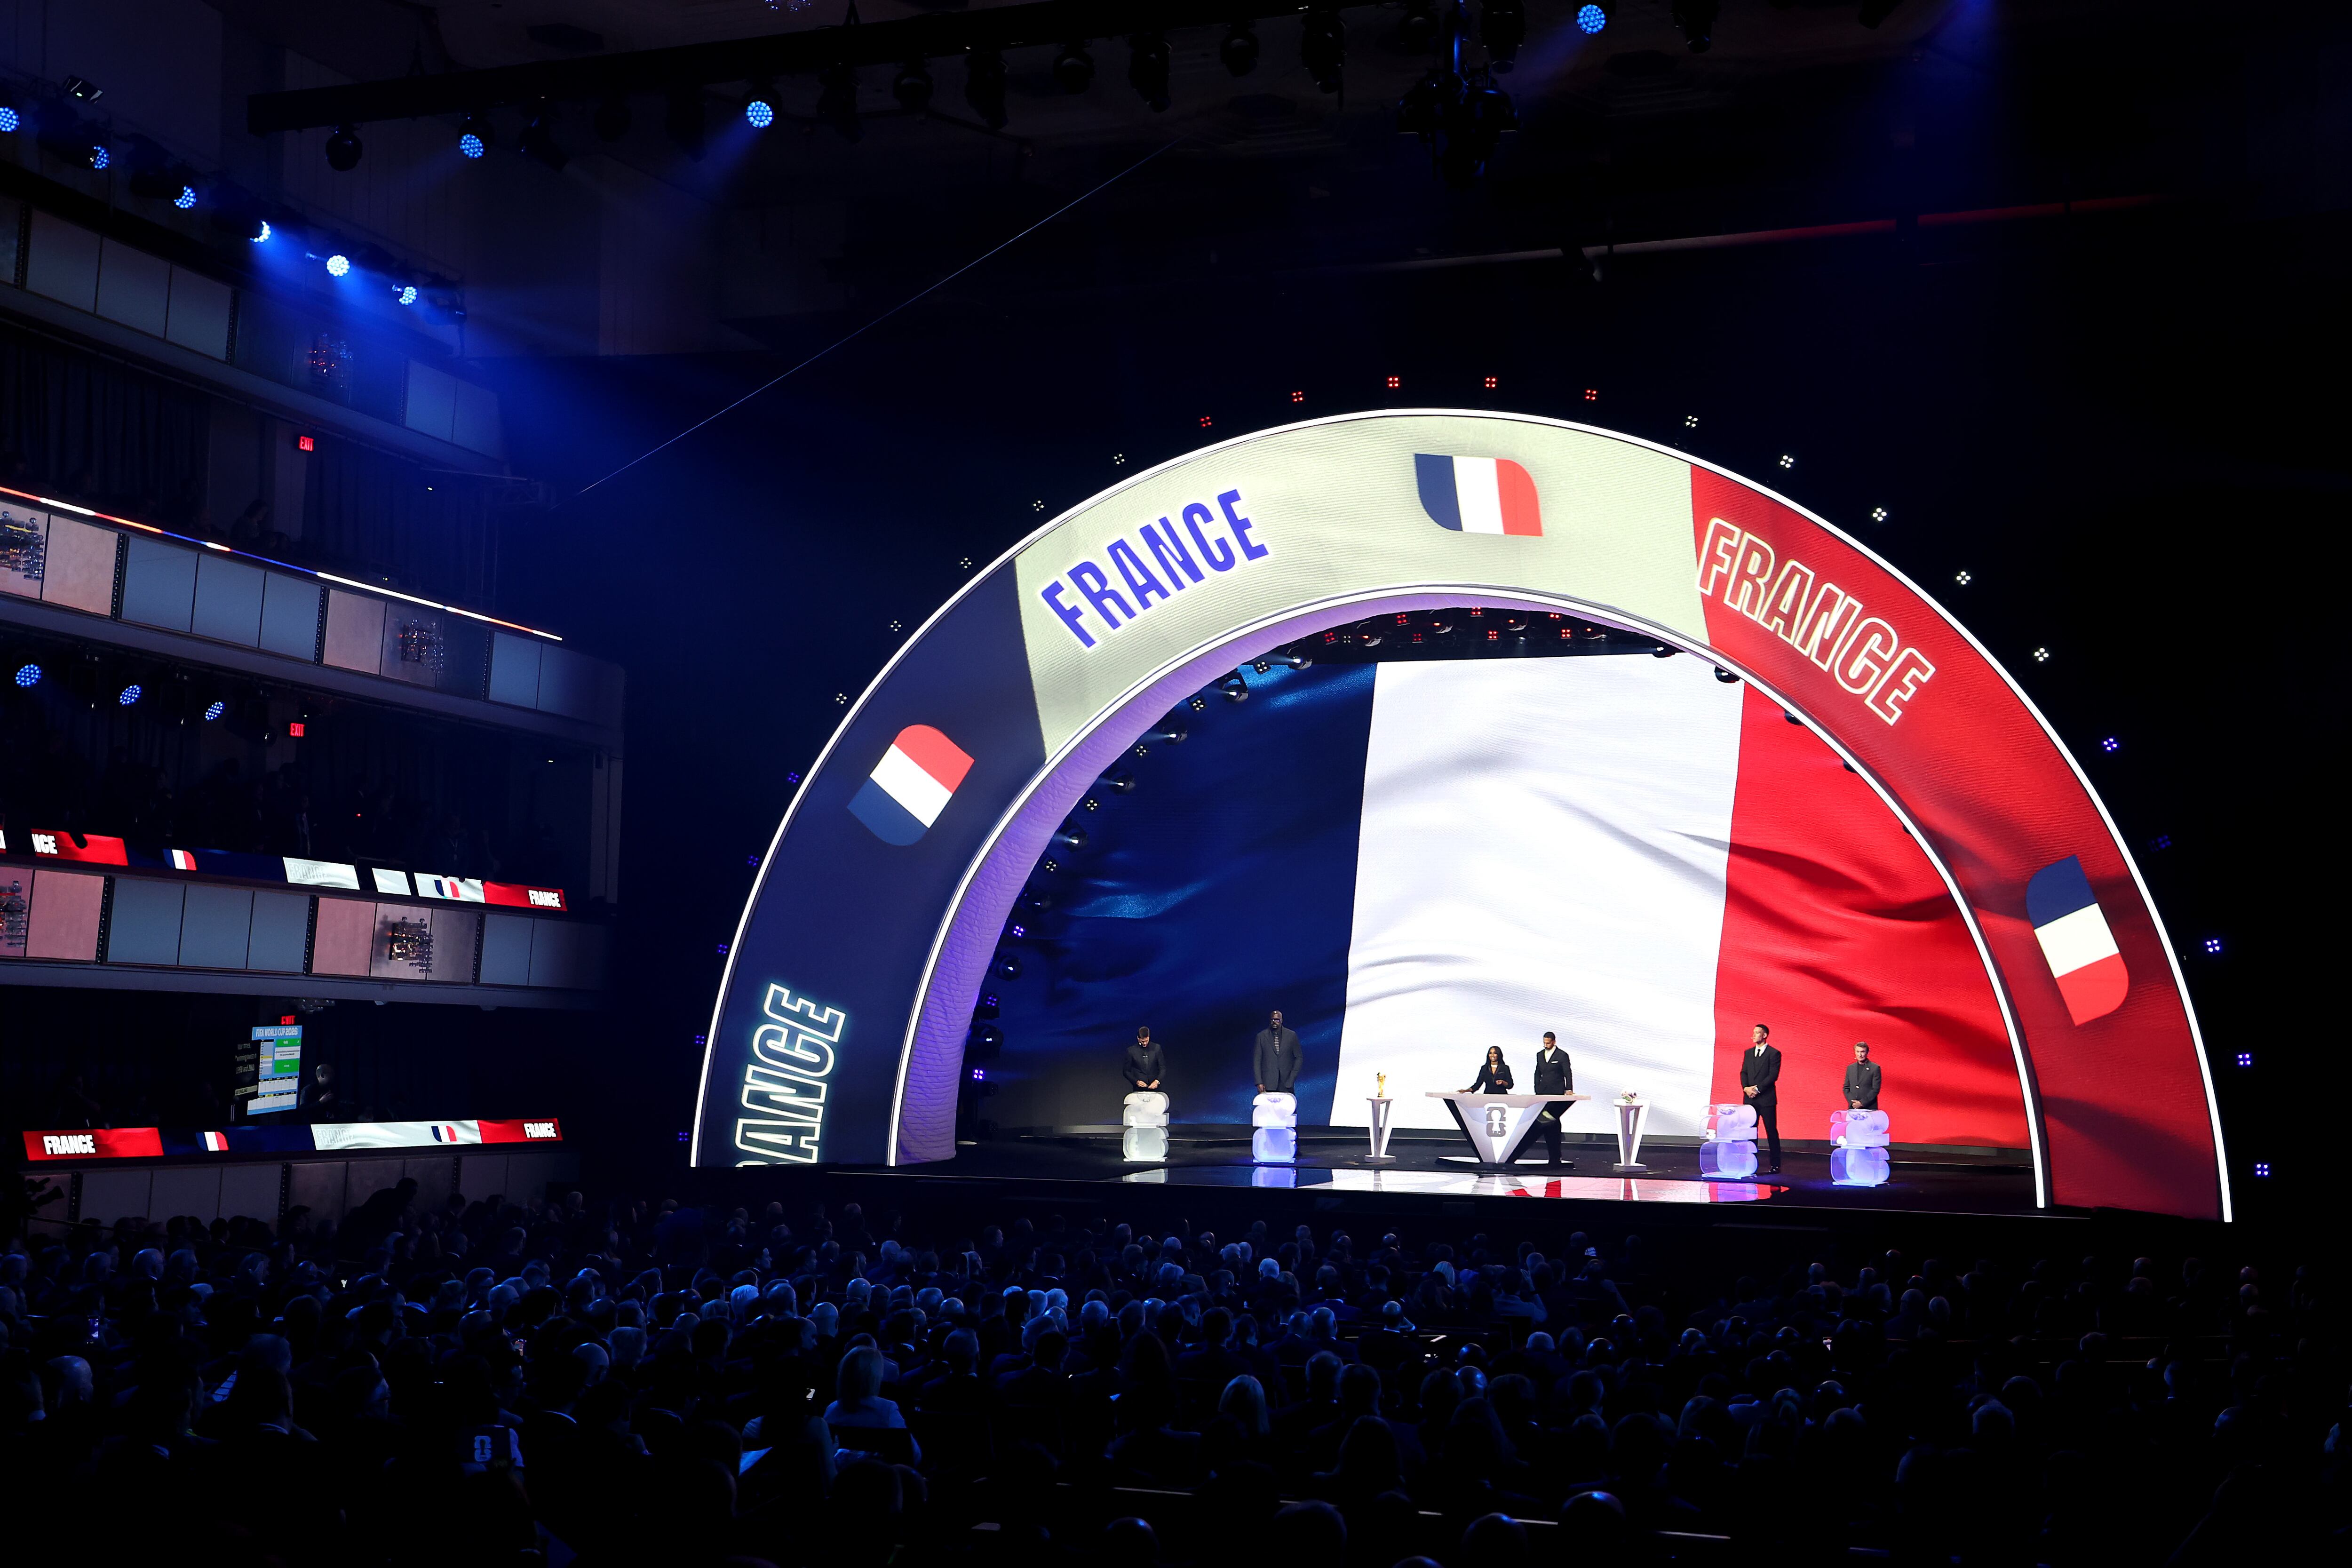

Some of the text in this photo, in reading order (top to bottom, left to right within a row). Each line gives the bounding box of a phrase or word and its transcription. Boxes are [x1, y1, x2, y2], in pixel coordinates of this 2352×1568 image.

[299, 436, 315, 452] EXIT
[1041, 488, 1270, 649] FRANCE
[1694, 517, 1936, 726] FRANCE
[289, 722, 305, 738] EXIT
[528, 890, 561, 907] FRANCE
[256, 1028, 264, 1037] FIFA
[264, 1028, 278, 1036] WORLD
[735, 982, 846, 1167] ANCE
[524, 1122, 557, 1138] FRANCE
[43, 1134, 96, 1155] FRANCE
